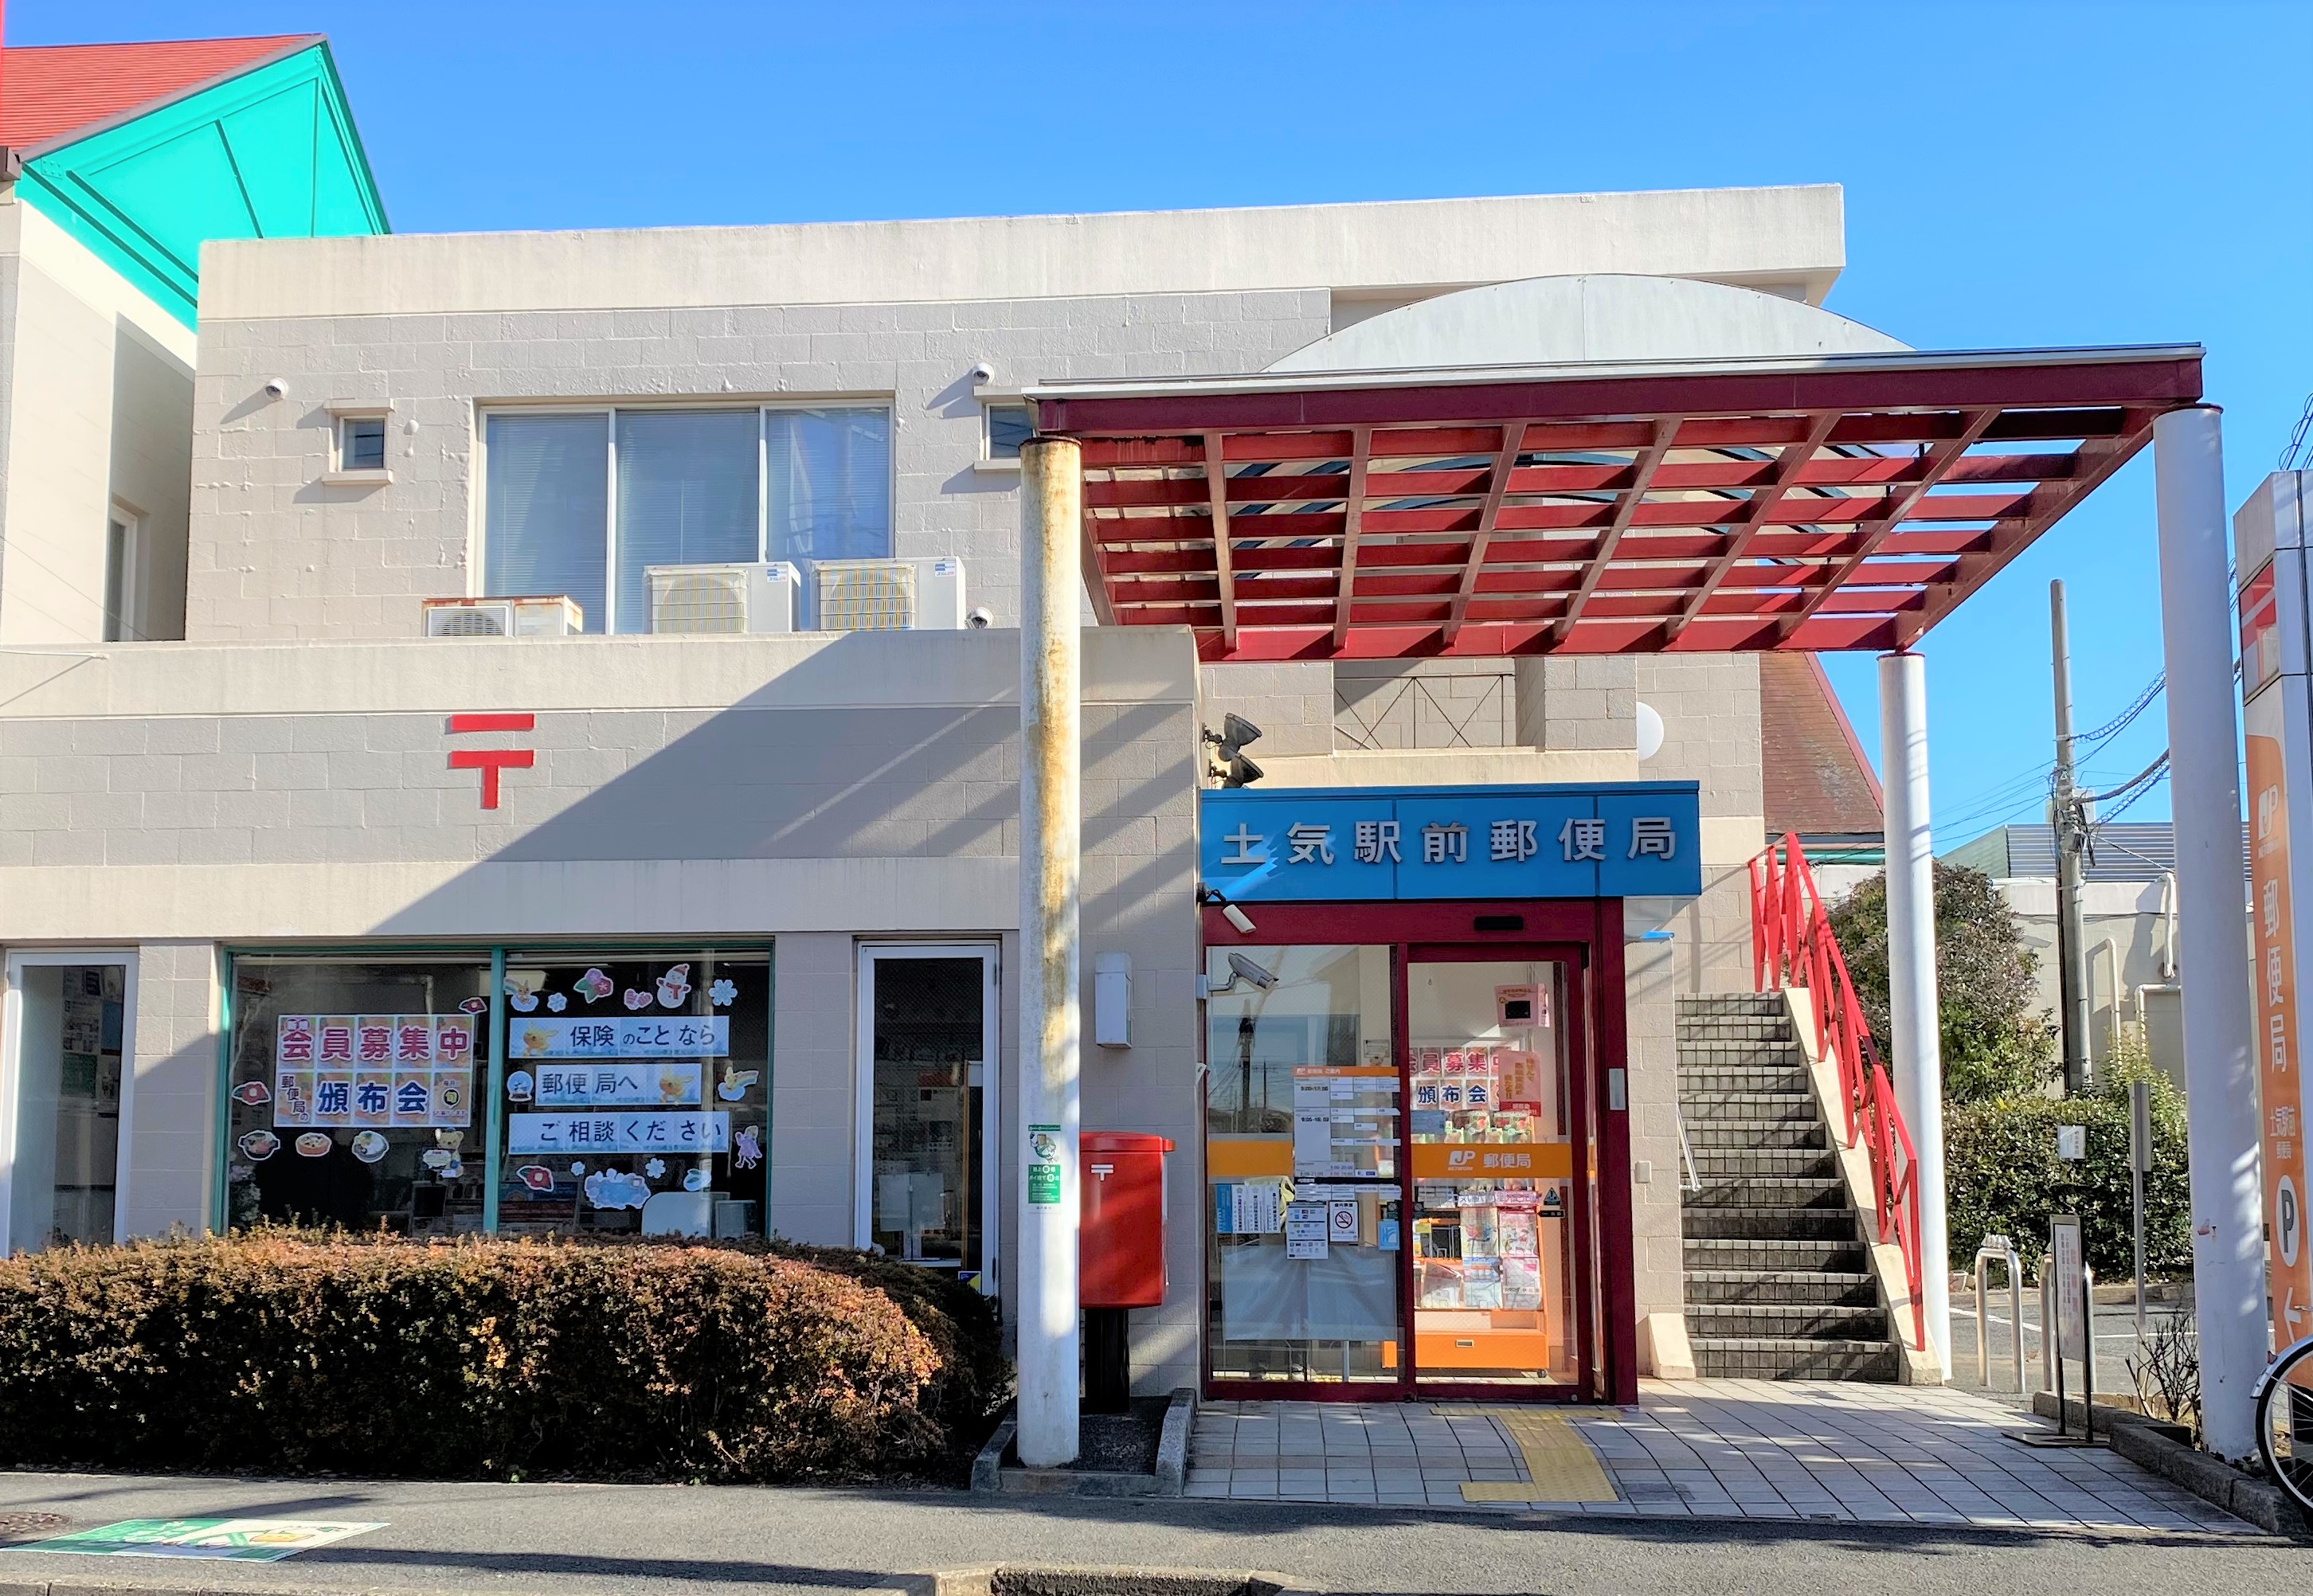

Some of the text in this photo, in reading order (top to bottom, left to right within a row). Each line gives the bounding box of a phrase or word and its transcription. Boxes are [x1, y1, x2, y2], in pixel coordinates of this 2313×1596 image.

[1220, 816, 1677, 866] 土気駅前郵便局
[2263, 878, 2288, 1074] 郵便局
[282, 1026, 468, 1059] 会員募集中
[570, 1024, 715, 1047] 保険のことなら
[542, 1072, 638, 1096] 郵便局へ
[1418, 1085, 1487, 1105] 頒布会
[318, 1081, 429, 1113] 頒布会
[540, 1120, 722, 1143] ご相談ください
[1483, 1152, 1532, 1169] 郵便局
